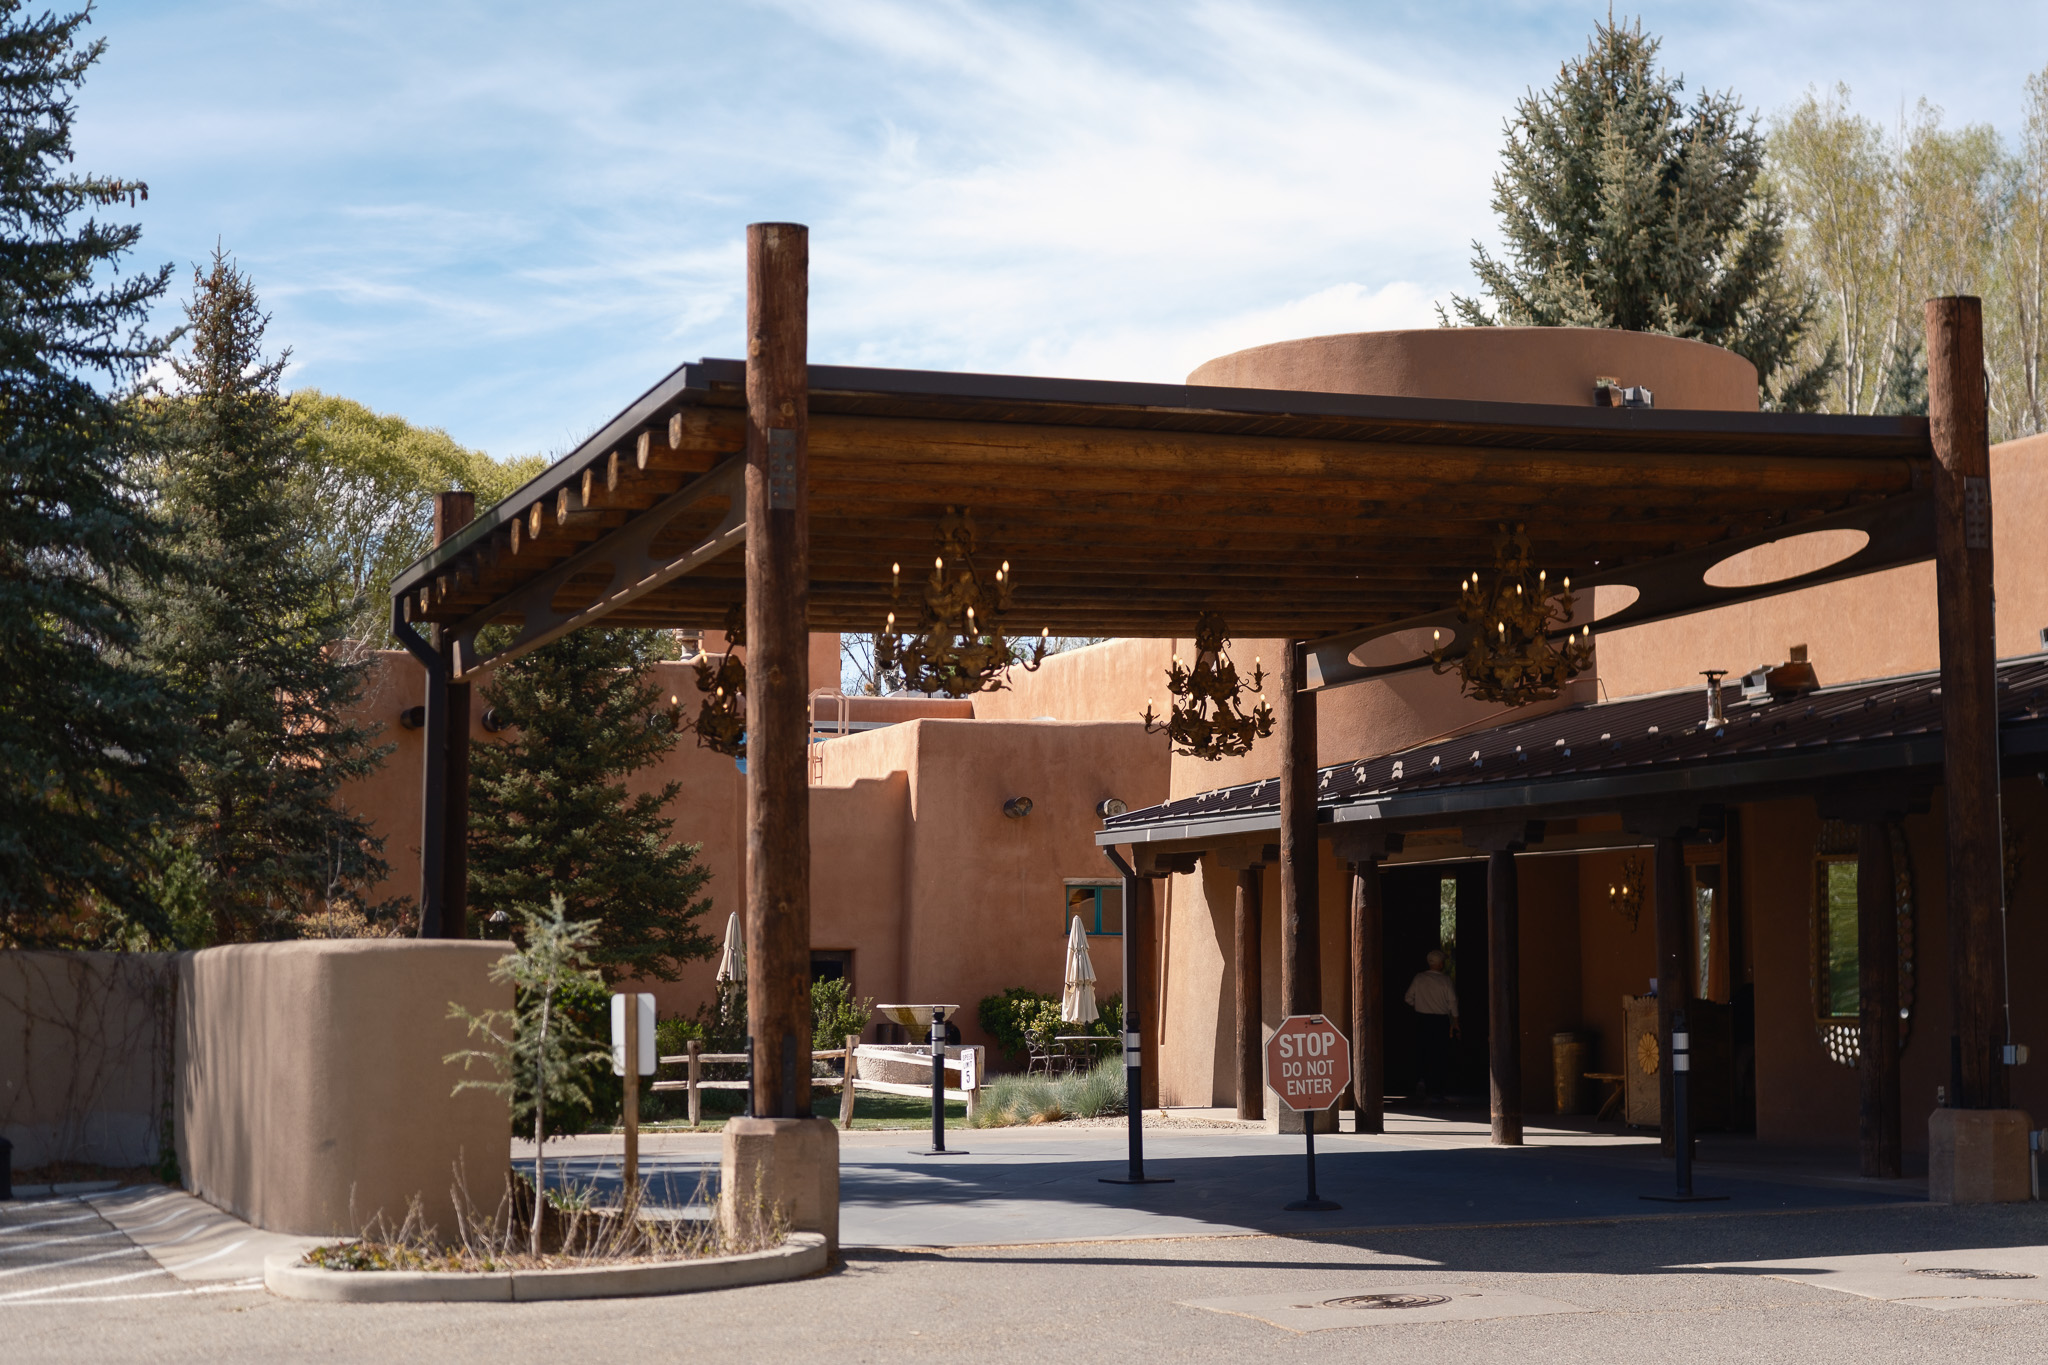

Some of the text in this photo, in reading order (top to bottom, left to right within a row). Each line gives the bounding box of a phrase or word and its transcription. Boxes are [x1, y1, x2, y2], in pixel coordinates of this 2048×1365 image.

[1279, 1032, 1335, 1058] STOP
[966, 1070, 971, 1083] 5
[1282, 1060, 1335, 1077] DO NOT
[1287, 1078, 1332, 1095] ENTER
